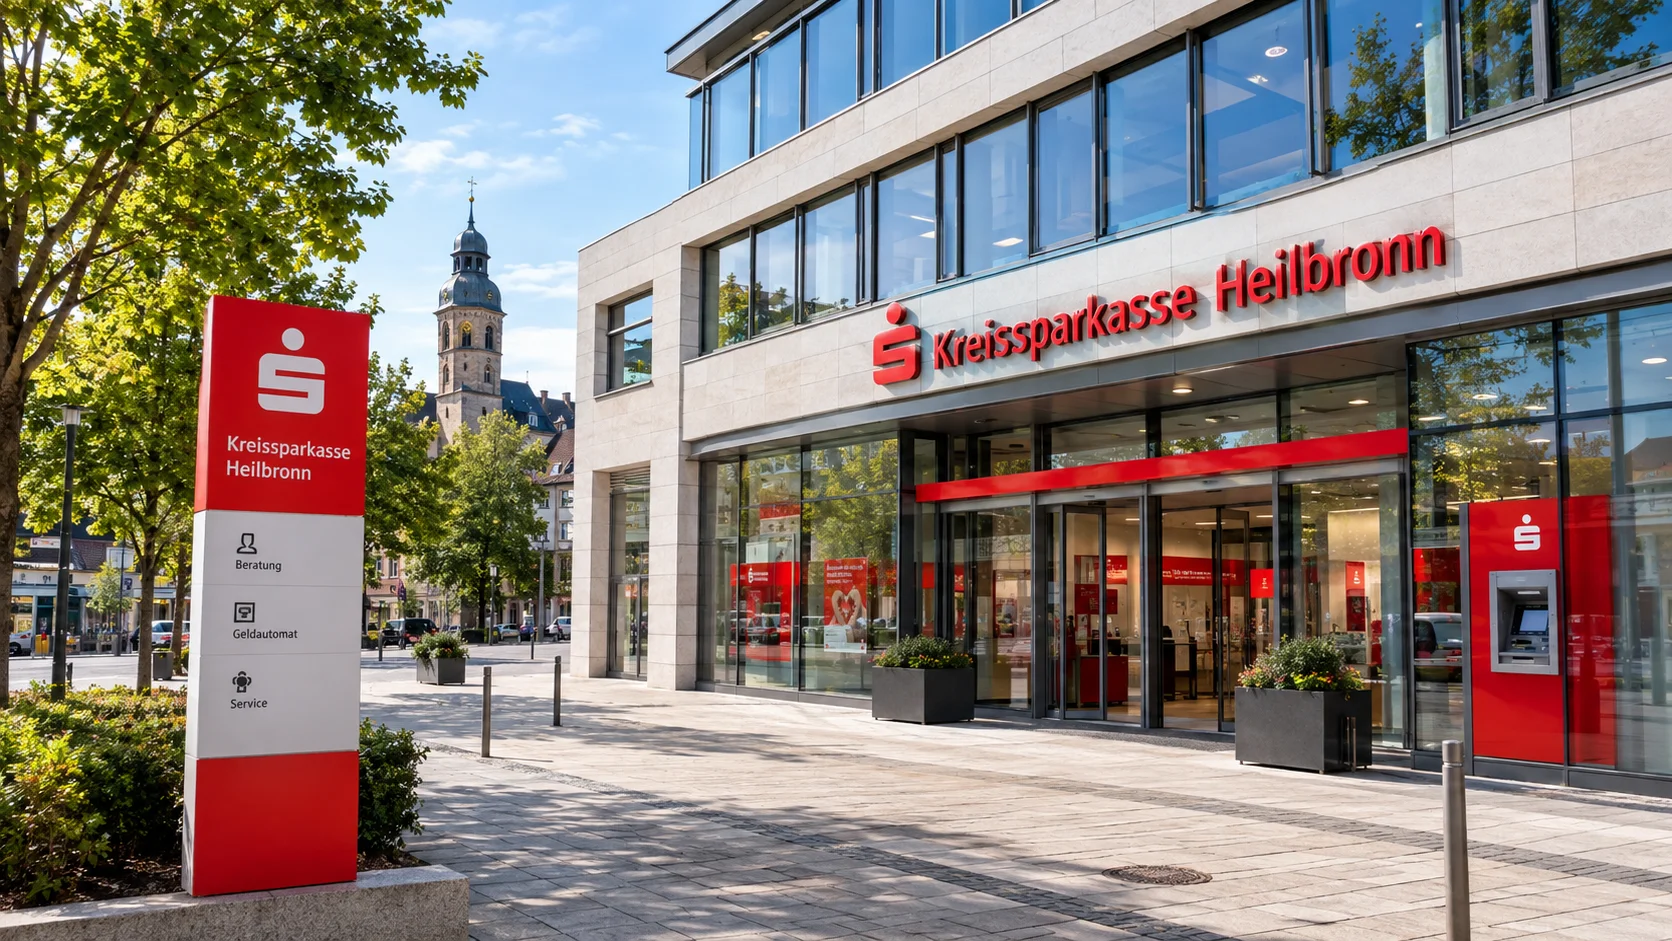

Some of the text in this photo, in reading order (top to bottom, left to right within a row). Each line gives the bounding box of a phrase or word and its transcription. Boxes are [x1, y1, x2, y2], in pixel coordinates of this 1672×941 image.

[933, 284, 1198, 370] Kreissparkasse
[1216, 225, 1446, 312] Heilbronn
[227, 435, 351, 461] Kreissparkasse
[226, 459, 312, 481] Heilbronn
[235, 559, 282, 573] Beratung
[232, 627, 298, 640] Geldautomat
[230, 697, 268, 709] Service
